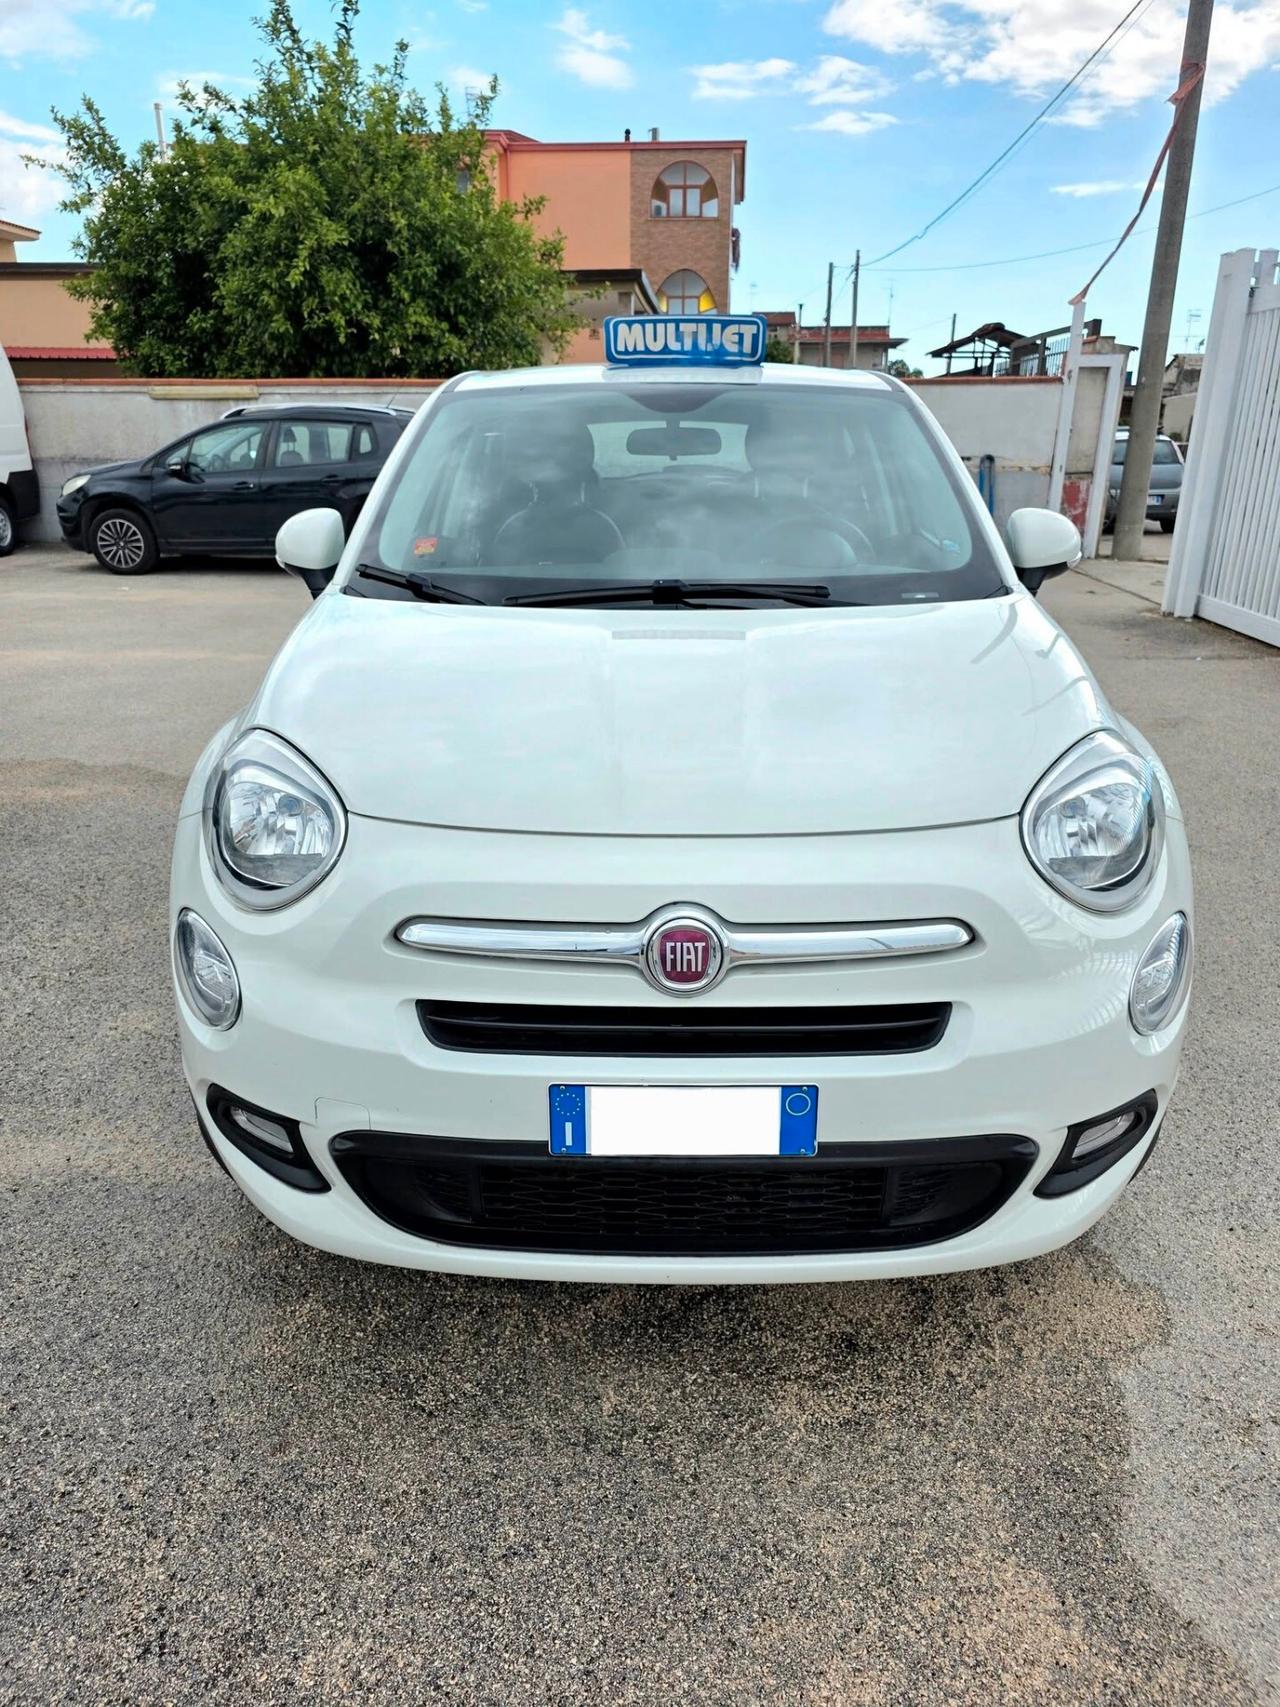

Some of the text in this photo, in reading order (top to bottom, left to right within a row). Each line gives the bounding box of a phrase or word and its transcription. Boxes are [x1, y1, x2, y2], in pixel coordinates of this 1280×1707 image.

[616, 322, 757, 353] MULTIJET
[665, 941, 706, 972] FIAT
[564, 1121, 573, 1146] I
